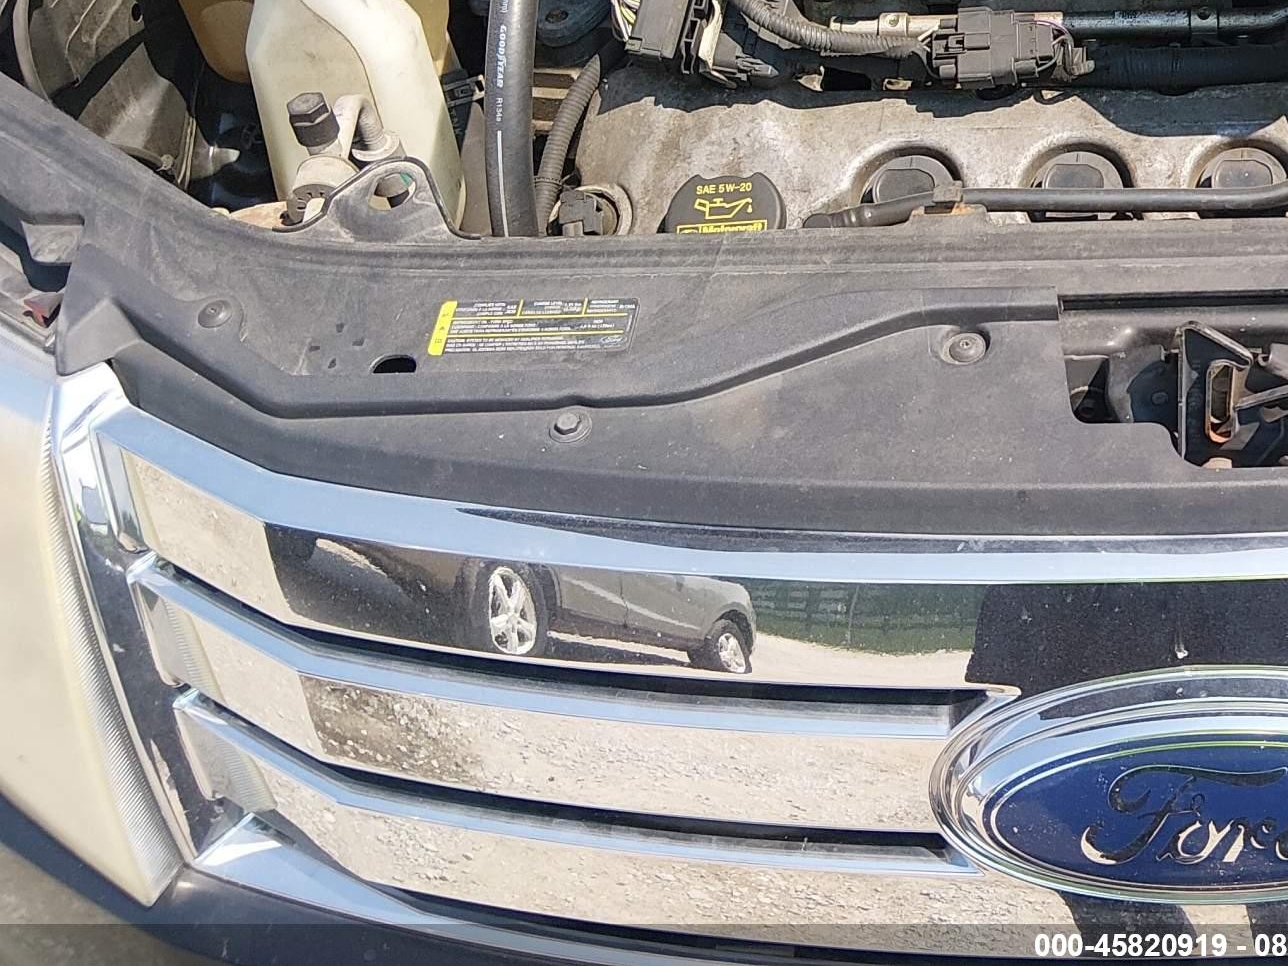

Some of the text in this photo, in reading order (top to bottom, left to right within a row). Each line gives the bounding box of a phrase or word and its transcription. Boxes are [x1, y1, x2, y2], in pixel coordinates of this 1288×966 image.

[496, 24, 507, 88] GOODYEAR
[696, 182, 752, 195] SAE 5W-20
